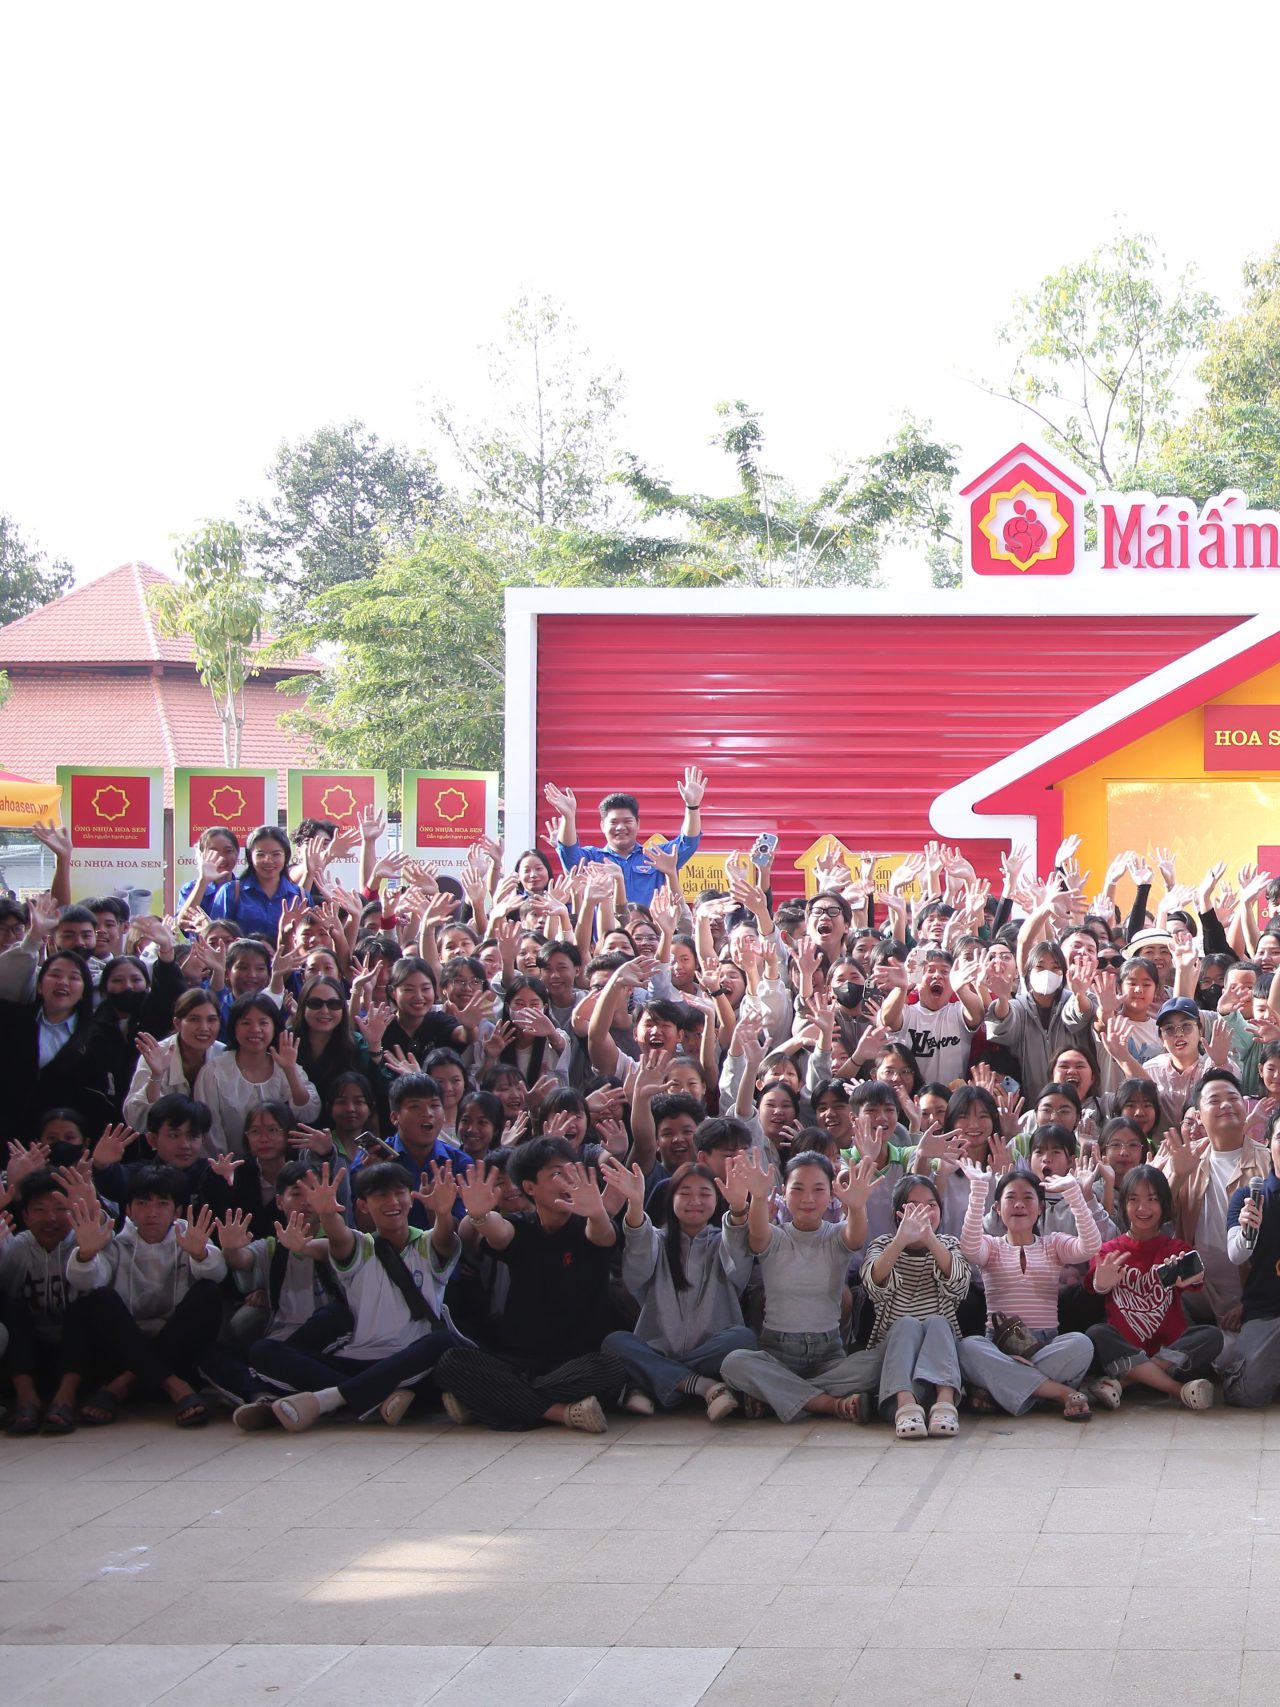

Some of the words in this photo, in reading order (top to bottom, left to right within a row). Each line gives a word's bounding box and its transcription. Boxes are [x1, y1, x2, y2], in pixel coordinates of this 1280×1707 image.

[1101, 504, 1190, 569] Mái
[1198, 497, 1280, 569] ấm
[1214, 730, 1263, 746] HOA
[85, 860, 113, 869] NHỰA
[686, 865, 704, 879] Mái
[707, 865, 722, 879] ấm
[683, 880, 698, 895] gia
